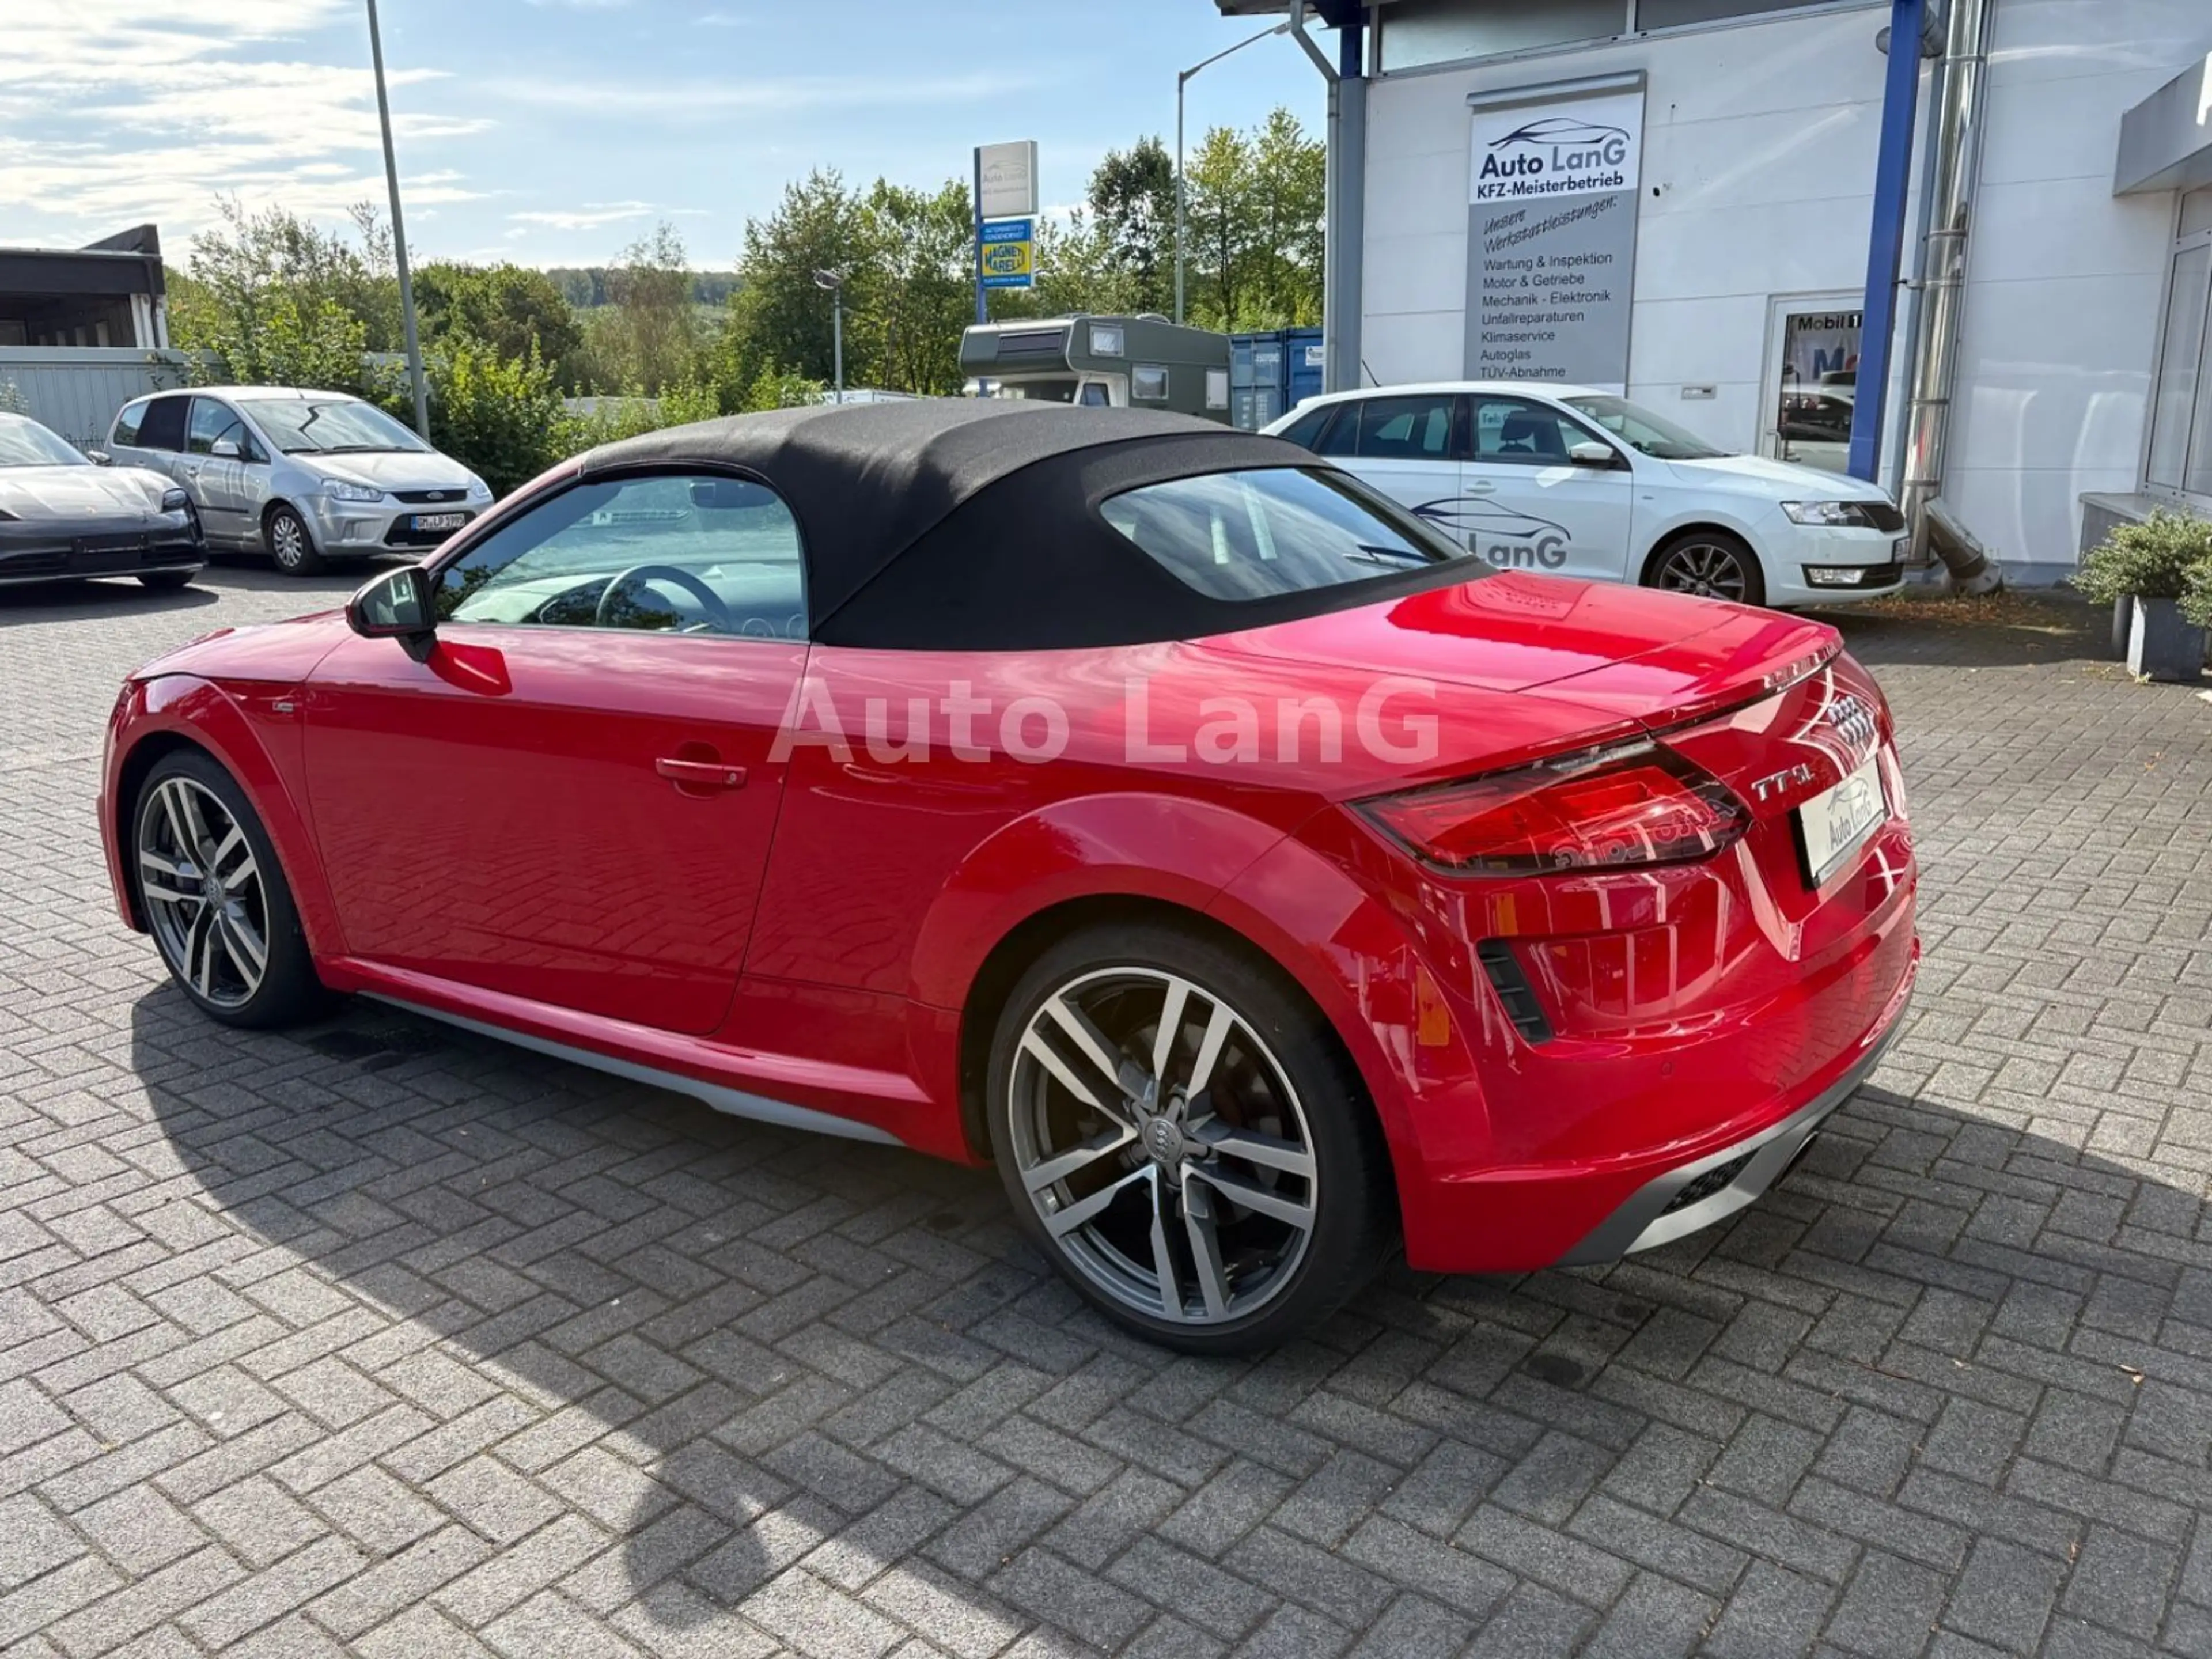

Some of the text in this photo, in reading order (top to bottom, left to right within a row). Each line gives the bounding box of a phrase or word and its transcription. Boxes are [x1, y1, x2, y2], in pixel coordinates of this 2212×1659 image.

[1479, 138, 1626, 179] Auto LanG
[1478, 171, 1624, 199] KFZ-Meisterbetrieb
[1483, 209, 1526, 235] Unsere
[1483, 252, 1612, 271] Wartung & Inspektion
[1483, 272, 1585, 289] Motor & Getriebe
[1482, 293, 1538, 307] Mechanik
[1550, 289, 1611, 305] Elektronik
[1482, 311, 1584, 326] Unfallreparaturen
[1798, 314, 1844, 331] Mobil
[1481, 330, 1556, 343] Klimaservice
[1480, 349, 1531, 363] Autoglas
[1480, 365, 1566, 378] TÜV-Abnahme
[1829, 815, 1852, 851] Auto
